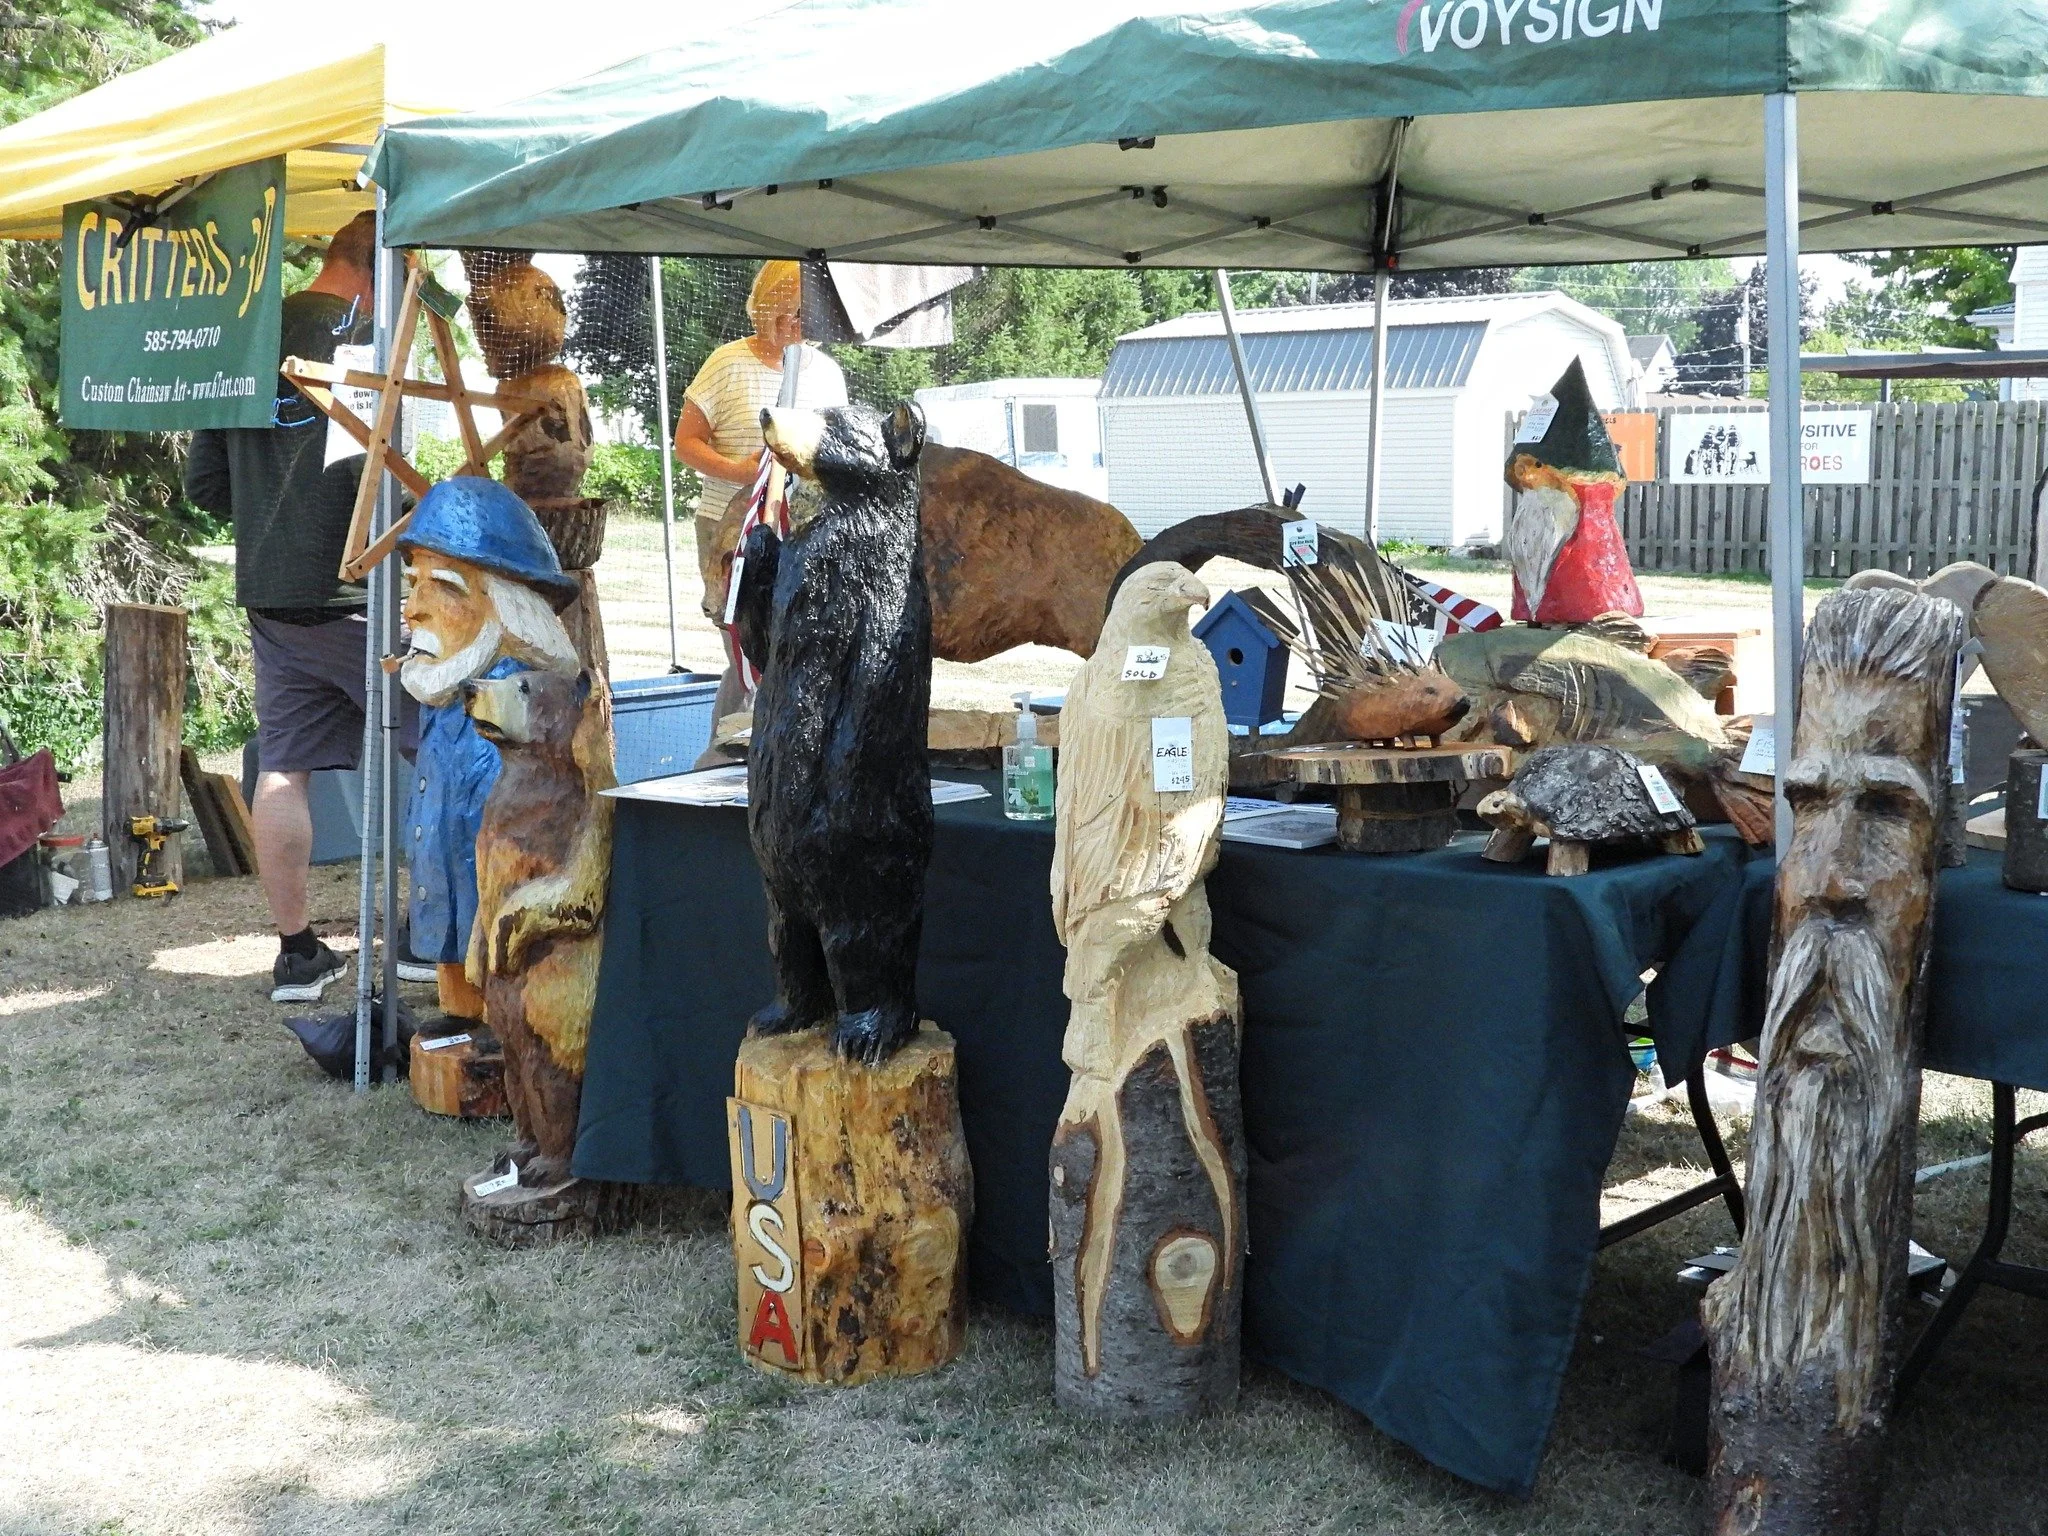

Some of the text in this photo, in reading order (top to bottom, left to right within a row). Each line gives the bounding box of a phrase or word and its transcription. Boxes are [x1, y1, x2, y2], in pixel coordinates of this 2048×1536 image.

[1419, 0, 1663, 52] VOYSIGN
[77, 211, 232, 311] CRITTERS
[143, 325, 221, 352] 585-794-0710
[82, 375, 124, 402] Custom
[128, 376, 172, 403] Chainsaw
[171, 375, 187, 402] Art
[1125, 669, 1157, 679] SOLD
[1156, 746, 1188, 758] EAGLE
[737, 1105, 799, 1365] USA
